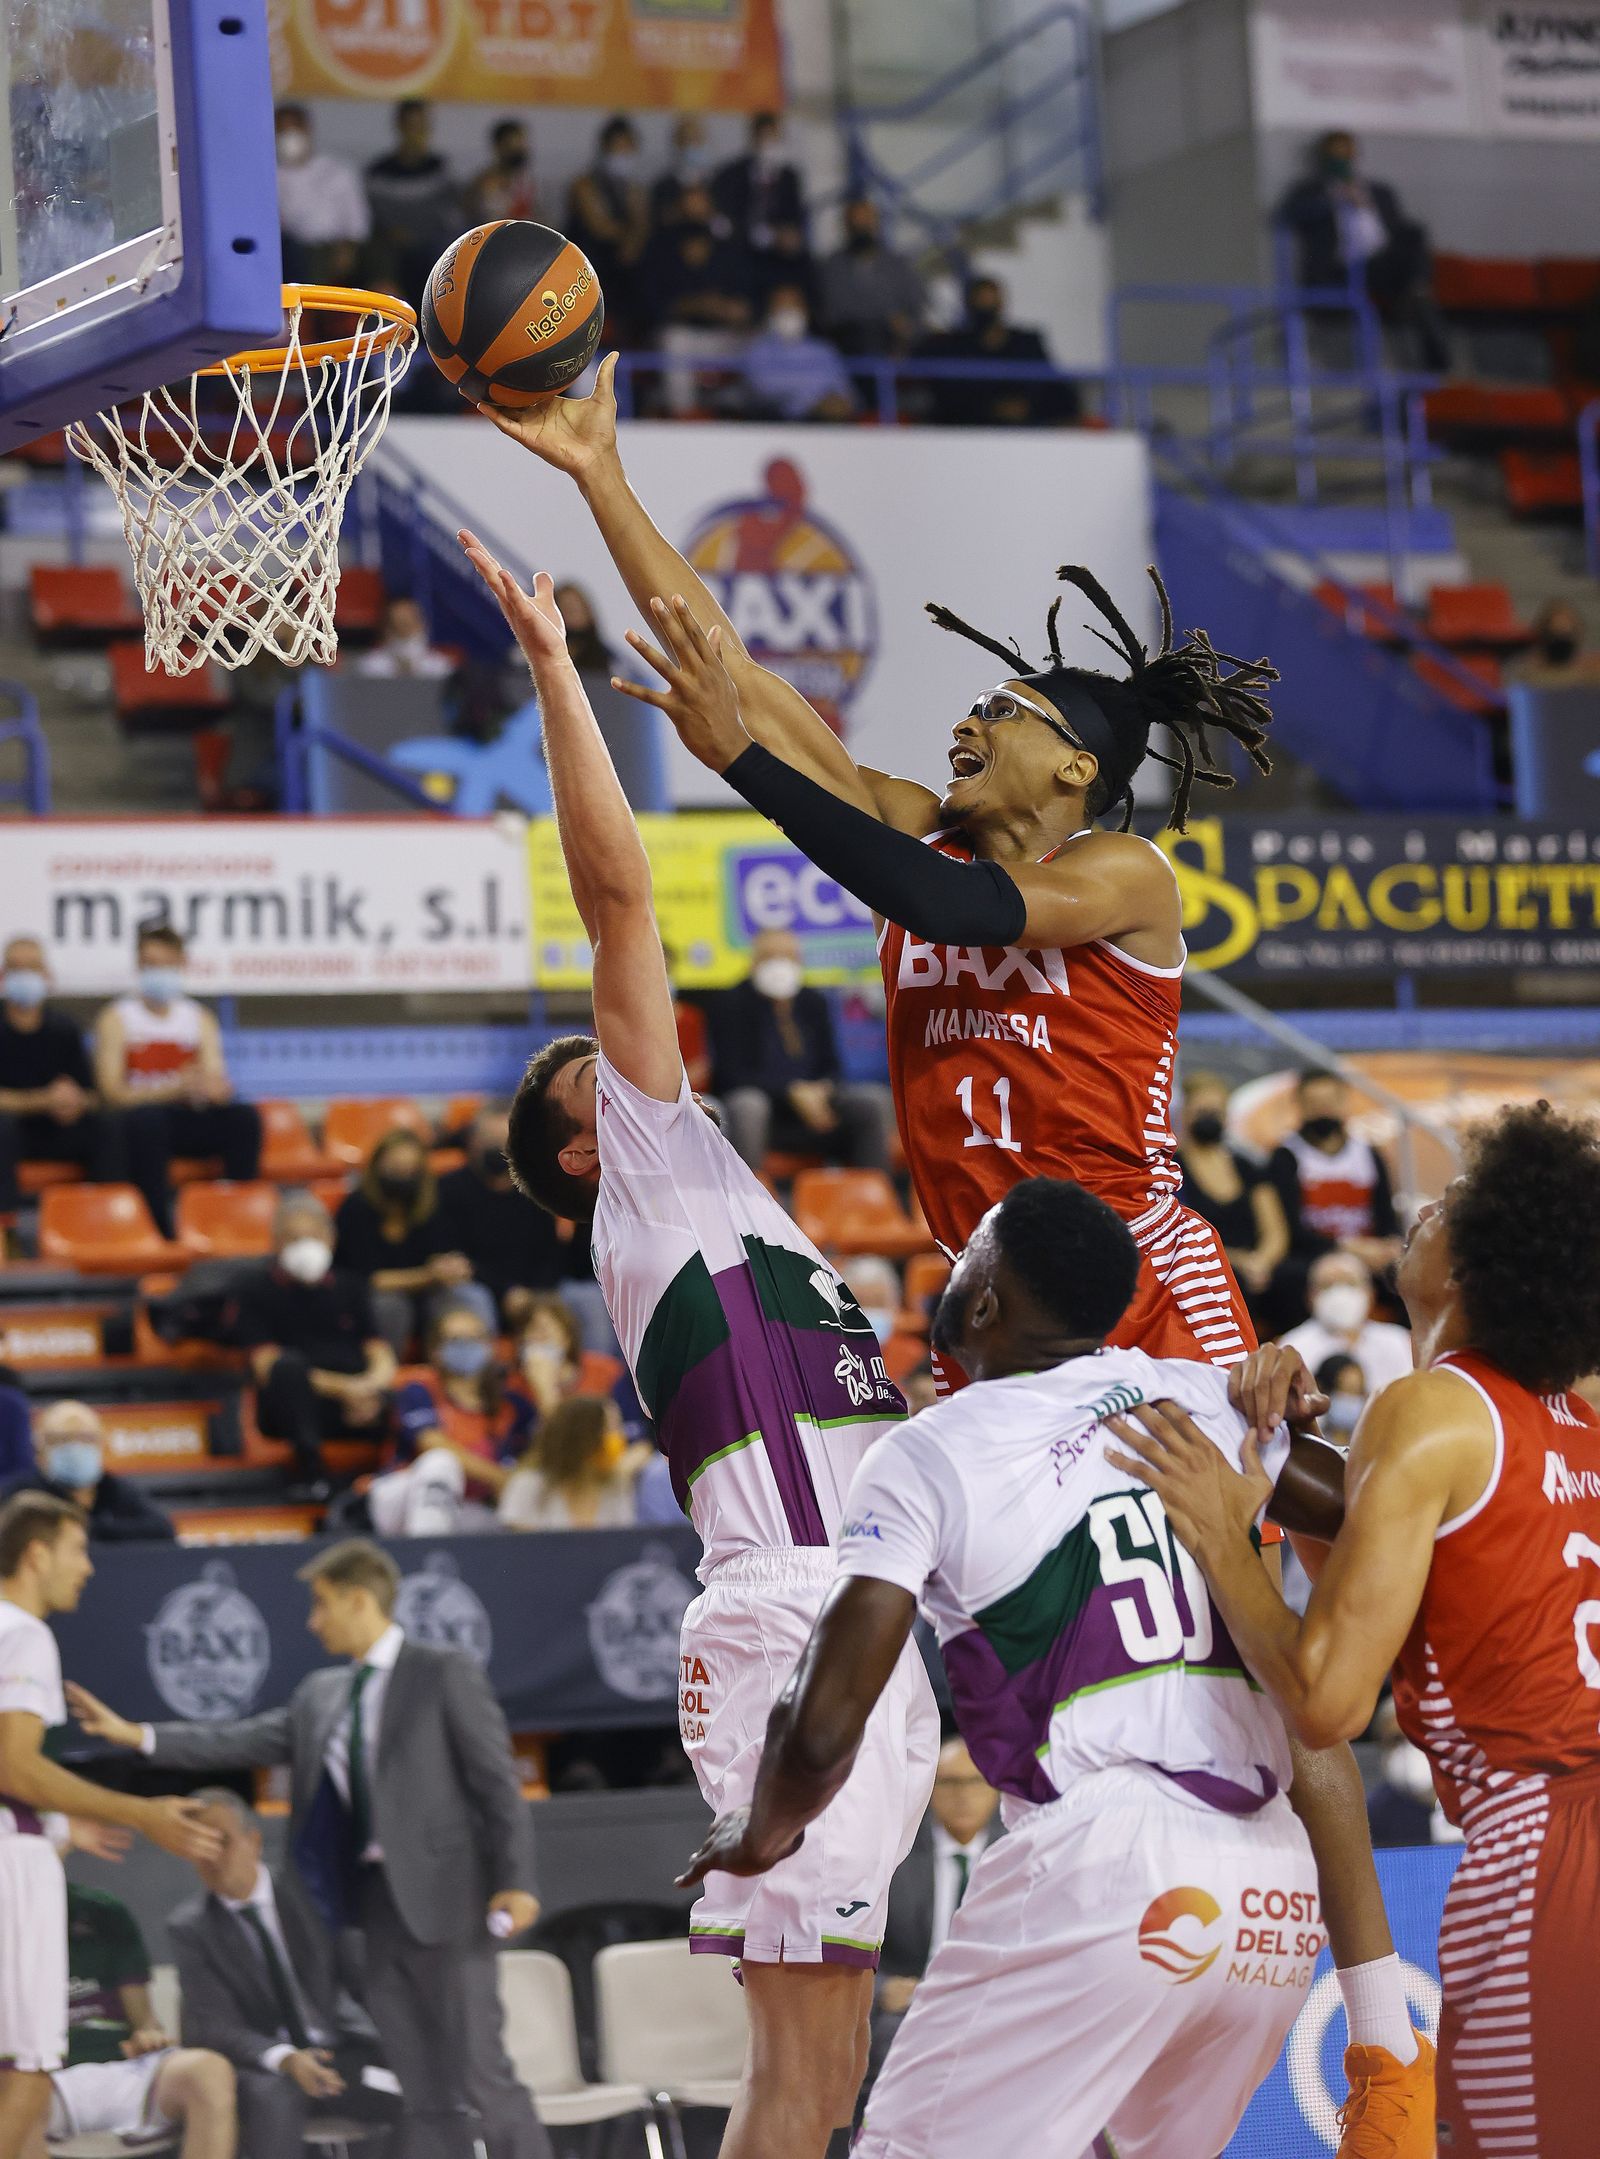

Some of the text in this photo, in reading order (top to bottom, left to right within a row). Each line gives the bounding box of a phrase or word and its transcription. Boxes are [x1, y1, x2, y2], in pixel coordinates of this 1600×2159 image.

[421, 875, 525, 942] s.l.
[744, 861, 873, 930] ec
[898, 930, 1070, 997] BAXI
[925, 1009, 1053, 1054] MANRESA
[956, 1076, 1022, 1153] 11
[1240, 1887, 1323, 1924] COST
[1235, 1928, 1288, 1955] DEL
